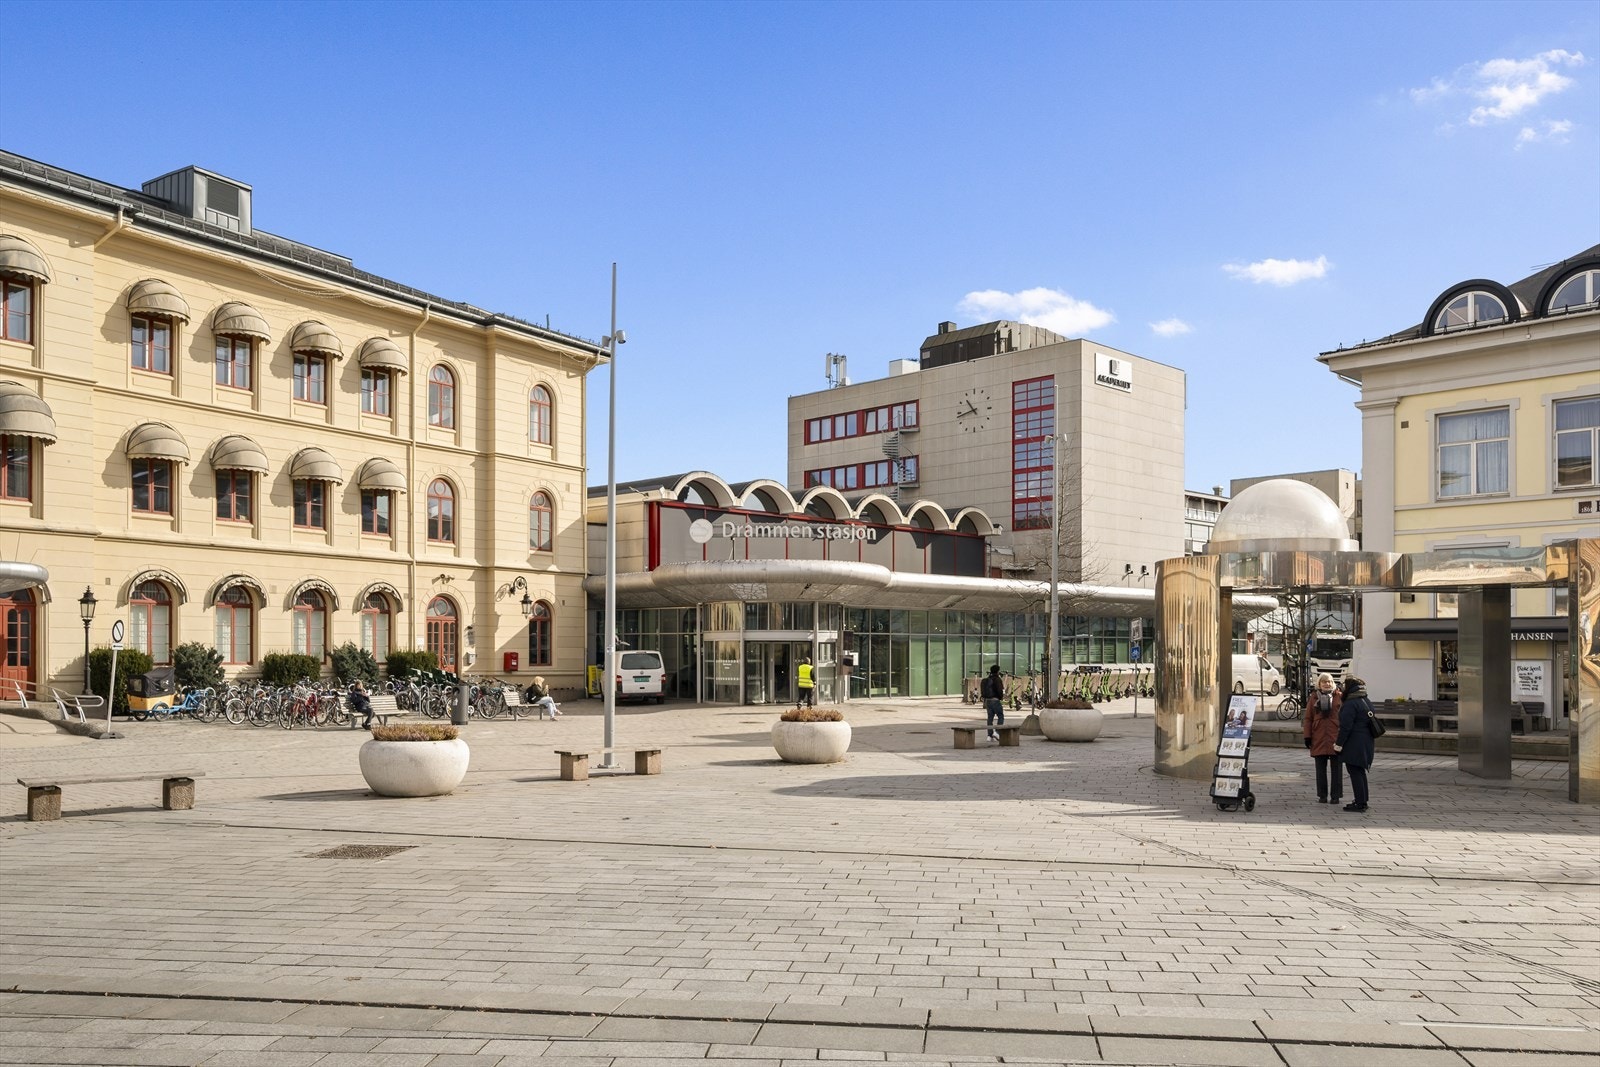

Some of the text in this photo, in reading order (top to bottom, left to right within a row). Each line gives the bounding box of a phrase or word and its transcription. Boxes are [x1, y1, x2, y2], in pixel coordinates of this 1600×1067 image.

[722, 521, 877, 544] Drammen stasjon
[1510, 632, 1554, 641] HANSEN
